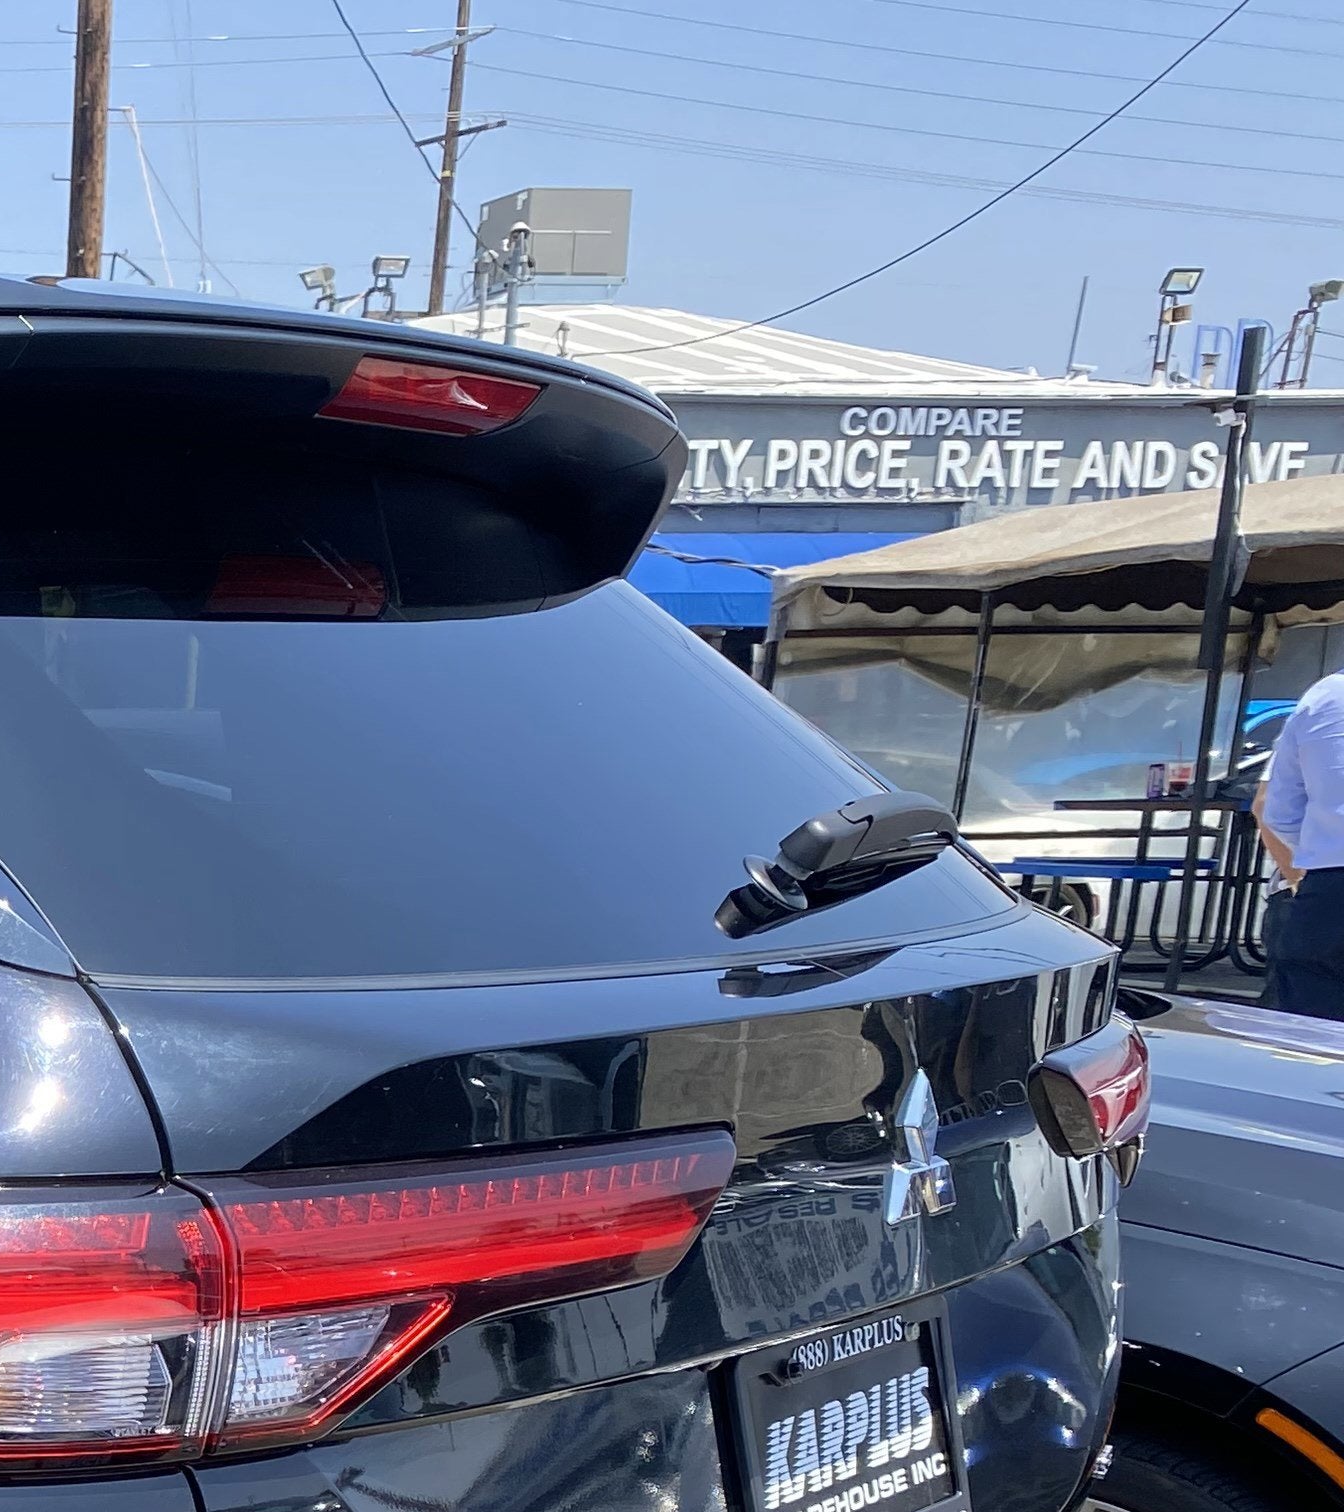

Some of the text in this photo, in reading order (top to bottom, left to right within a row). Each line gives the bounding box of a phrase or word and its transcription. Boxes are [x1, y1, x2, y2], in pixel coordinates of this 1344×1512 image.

[839, 406, 1025, 437] COMPARE
[679, 439, 1310, 499] TY, PRICE, RATE AND SVE
[793, 1315, 904, 1370] (888) KARPLUS
[764, 1366, 934, 1511] KARPLUS
[911, 1452, 949, 1486] INC
